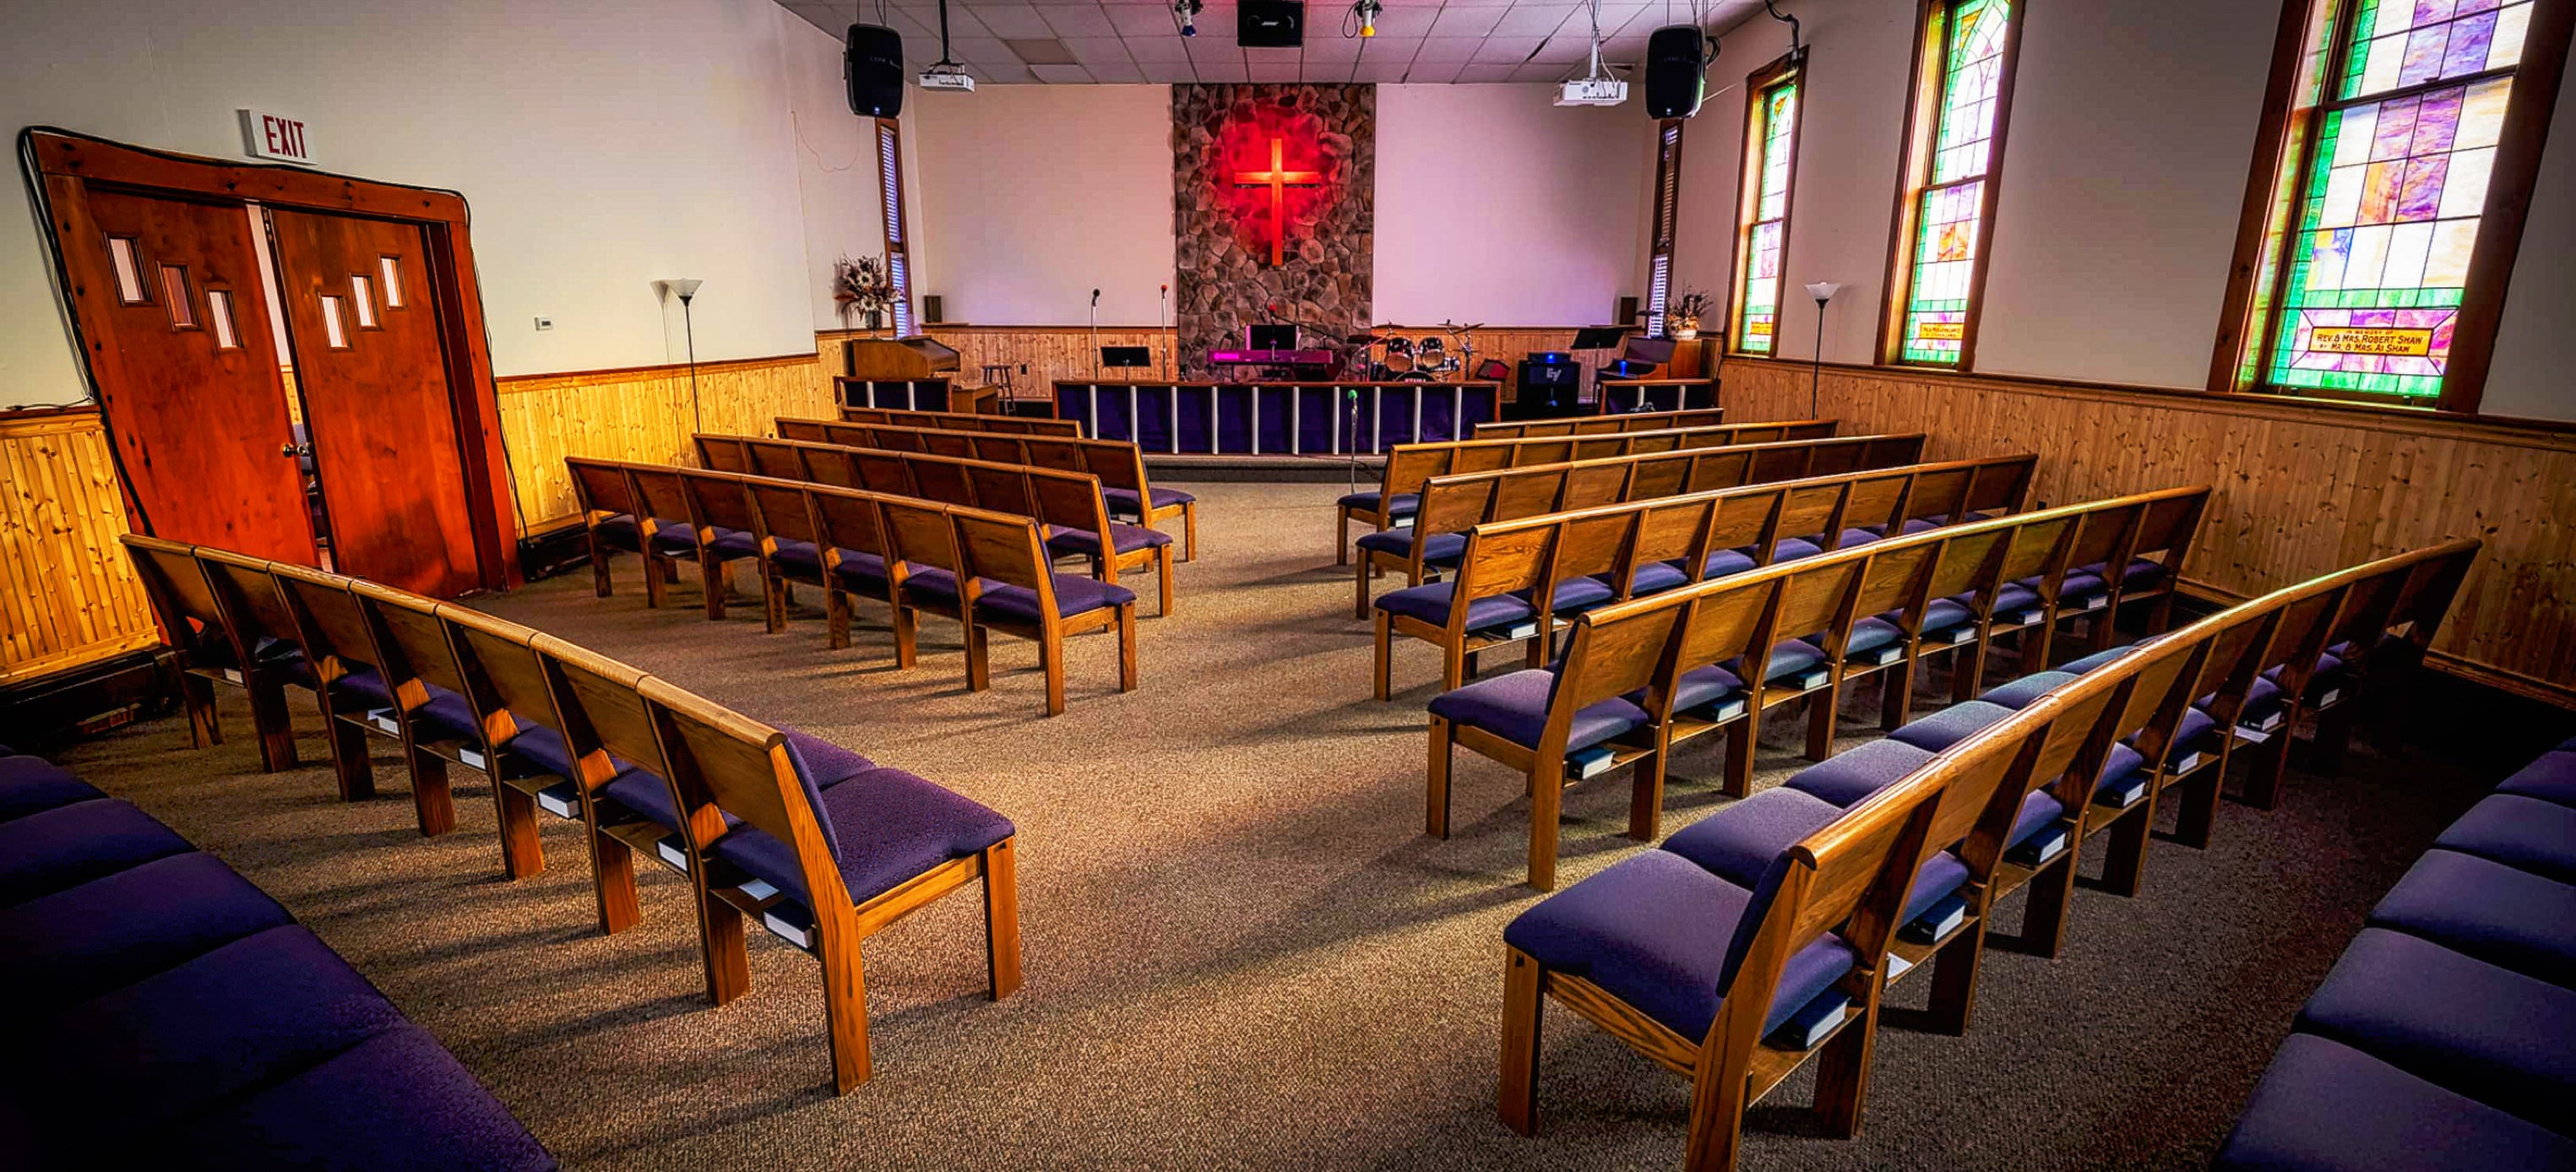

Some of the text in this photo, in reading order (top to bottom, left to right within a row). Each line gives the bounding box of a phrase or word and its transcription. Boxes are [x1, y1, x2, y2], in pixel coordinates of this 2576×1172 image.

[263, 115, 307, 159] EXIT
[2361, 334, 2396, 345] ROBERT
[2397, 335, 2423, 345] SHAW
[2385, 344, 2410, 353] SHAW
